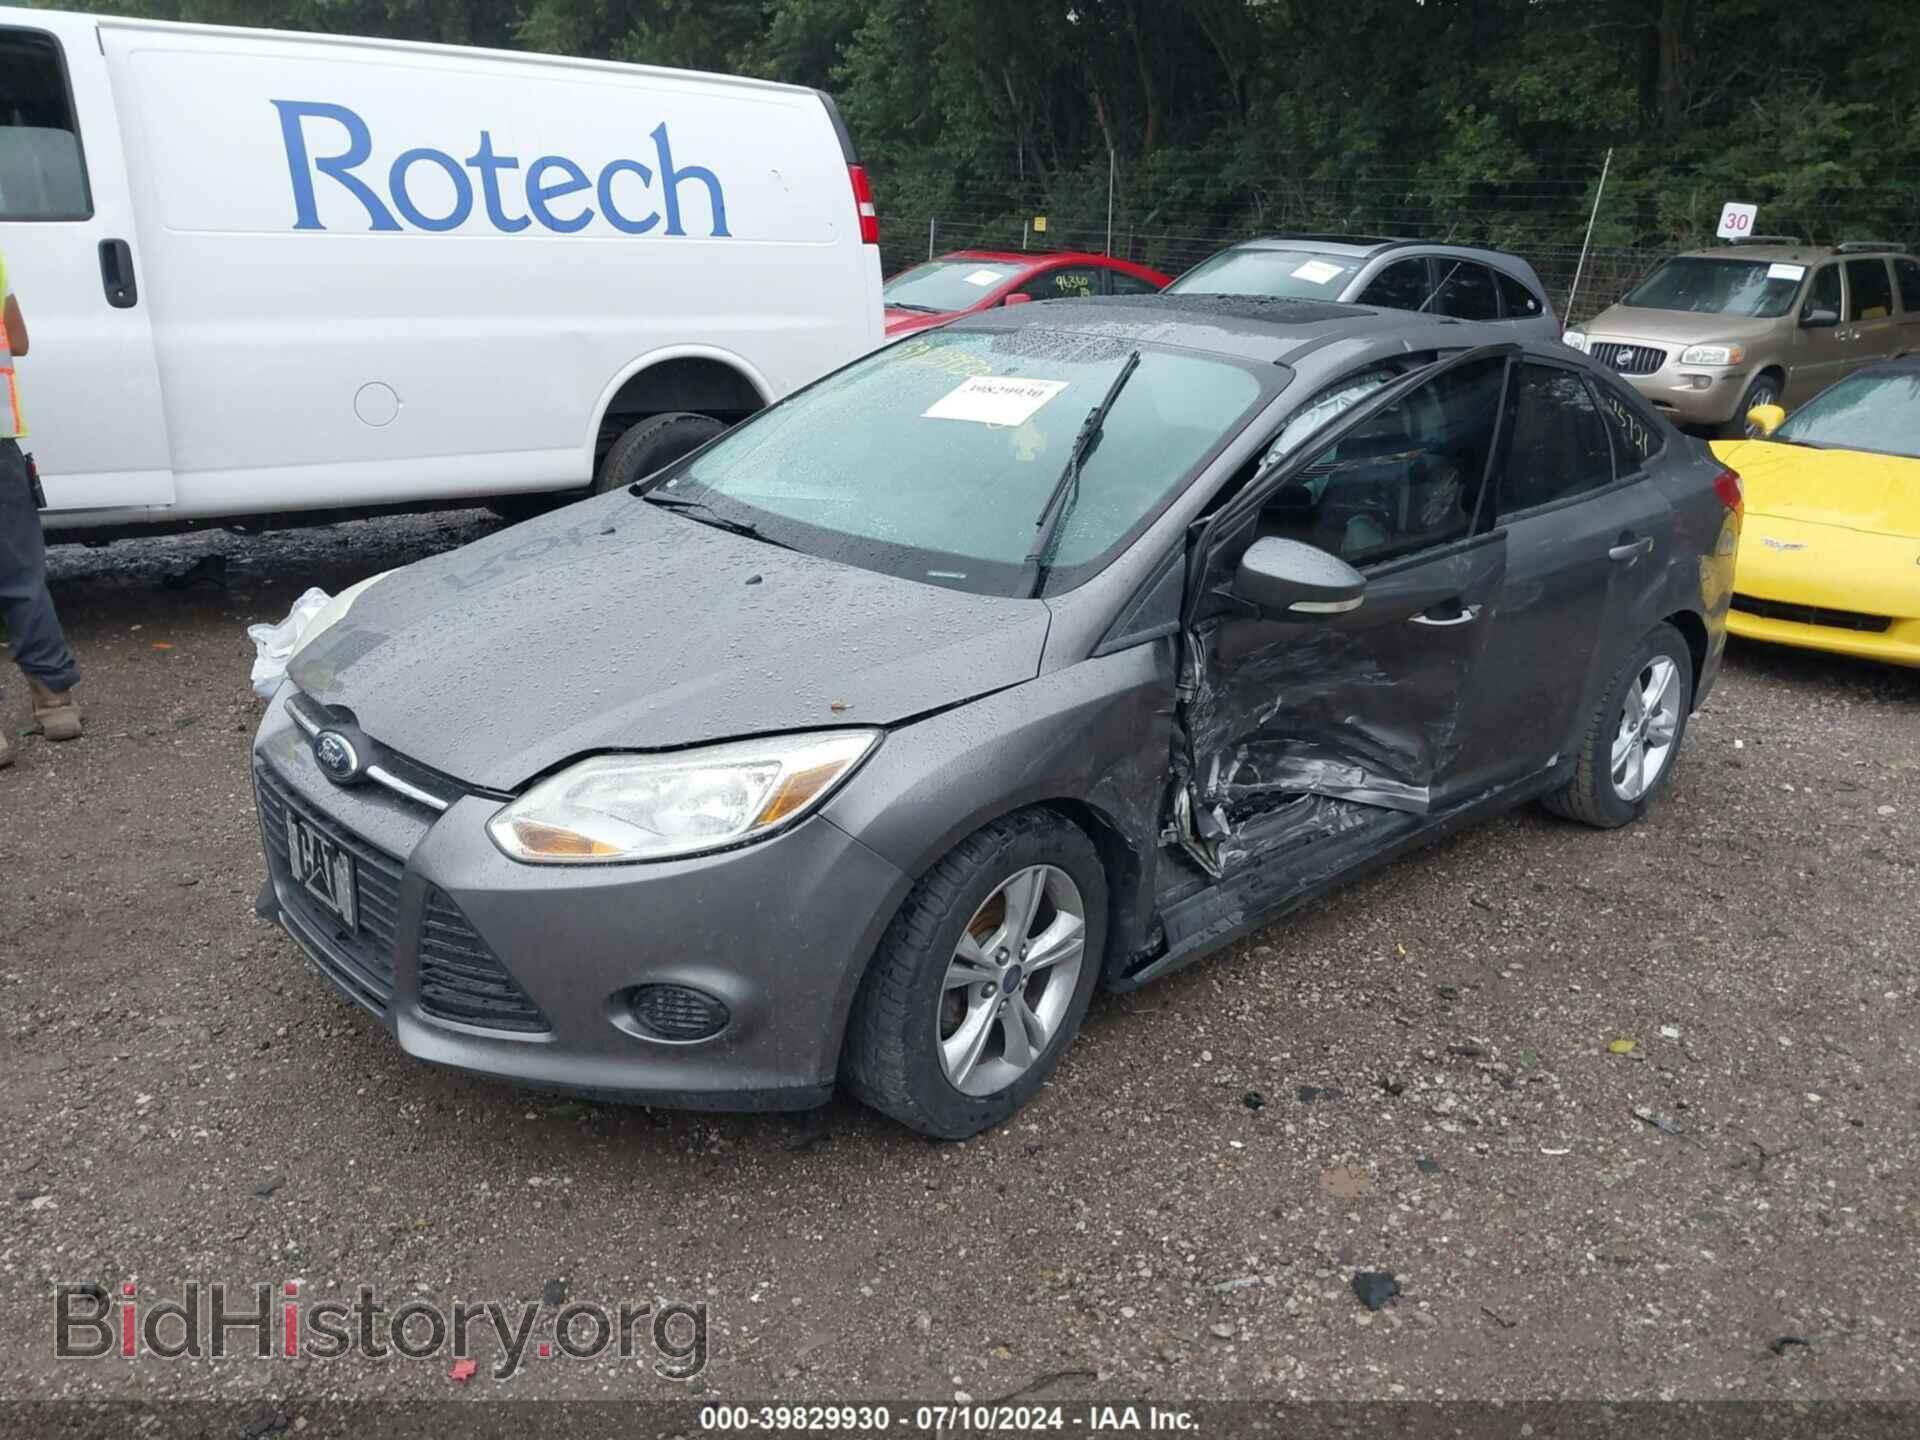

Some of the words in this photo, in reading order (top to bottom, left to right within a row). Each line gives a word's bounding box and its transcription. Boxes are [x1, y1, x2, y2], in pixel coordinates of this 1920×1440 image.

[270, 99, 732, 237] Rotech
[1725, 213, 1748, 230] 30
[318, 738, 343, 768] Ford
